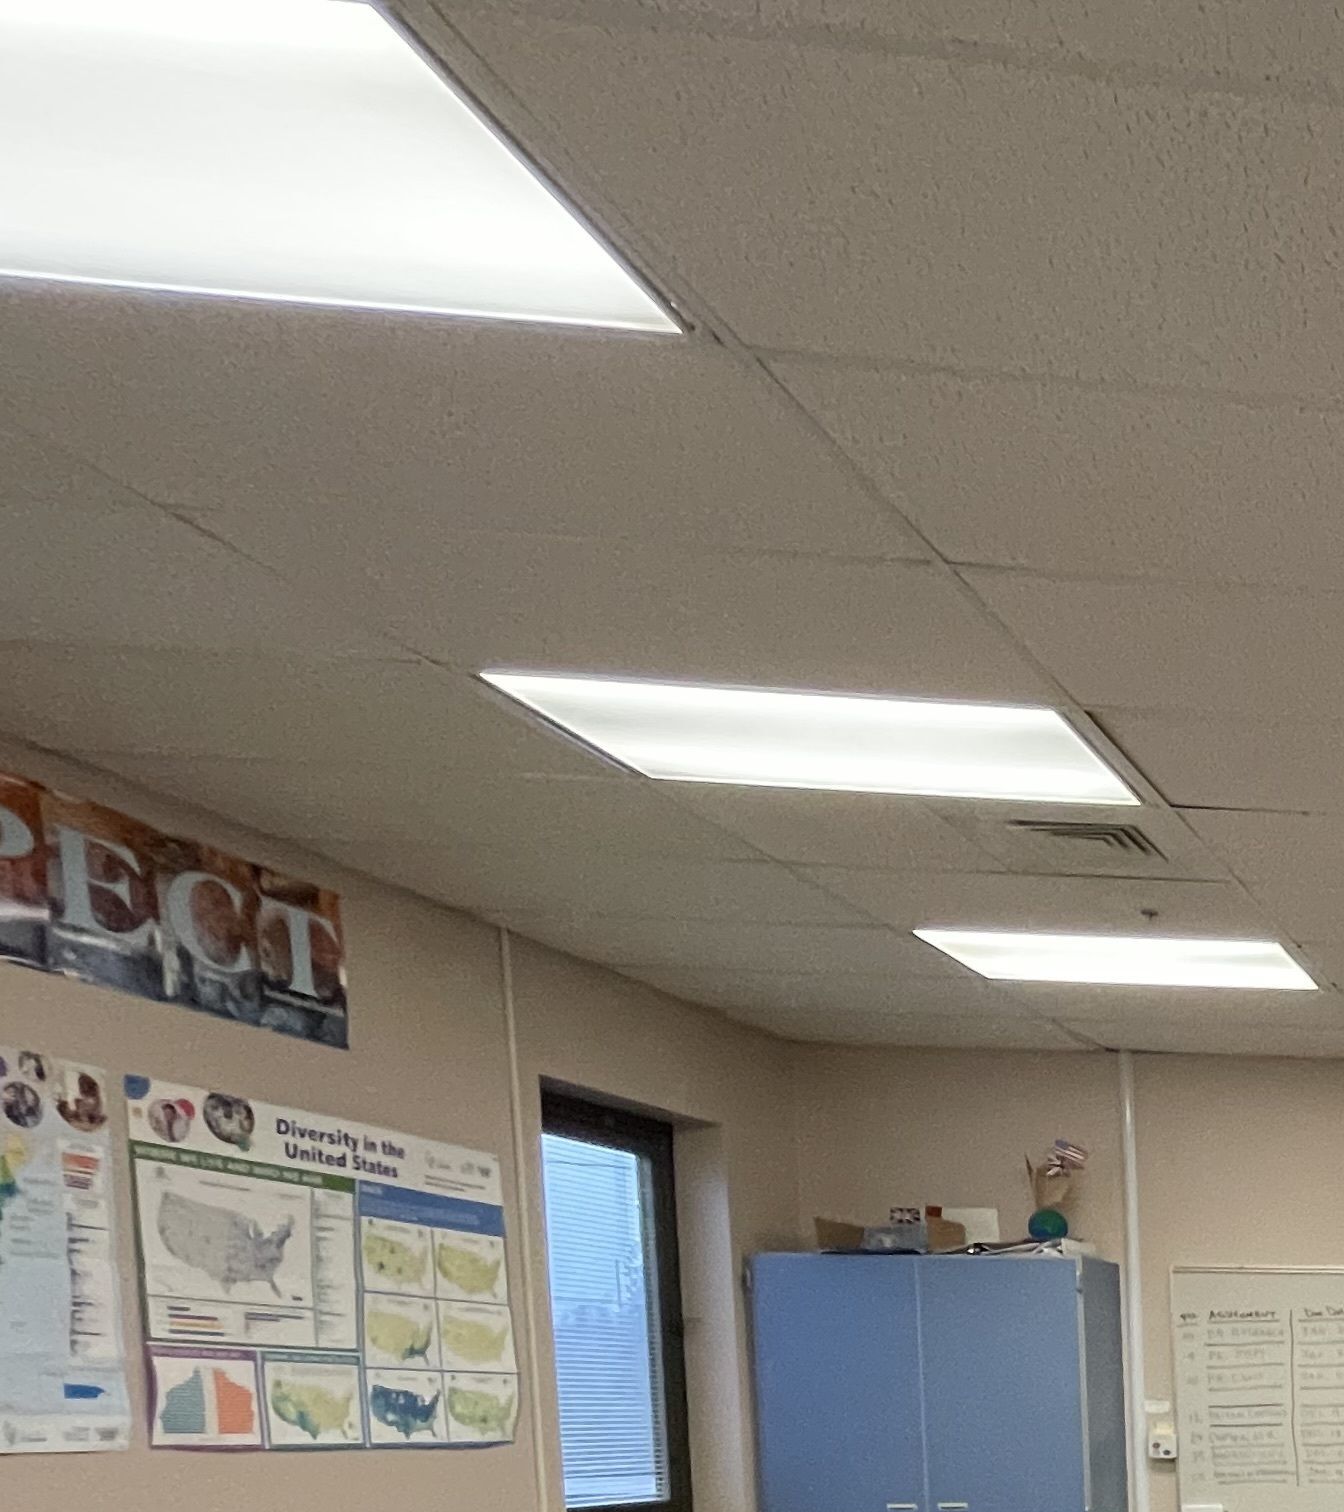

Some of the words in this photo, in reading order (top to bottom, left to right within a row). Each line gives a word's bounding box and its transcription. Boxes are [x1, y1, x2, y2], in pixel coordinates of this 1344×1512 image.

[275, 1117, 358, 1151] Diversity
[363, 1135, 378, 1151] in
[381, 1140, 405, 1160] the
[284, 1141, 347, 1168] United
[352, 1154, 398, 1179] States
